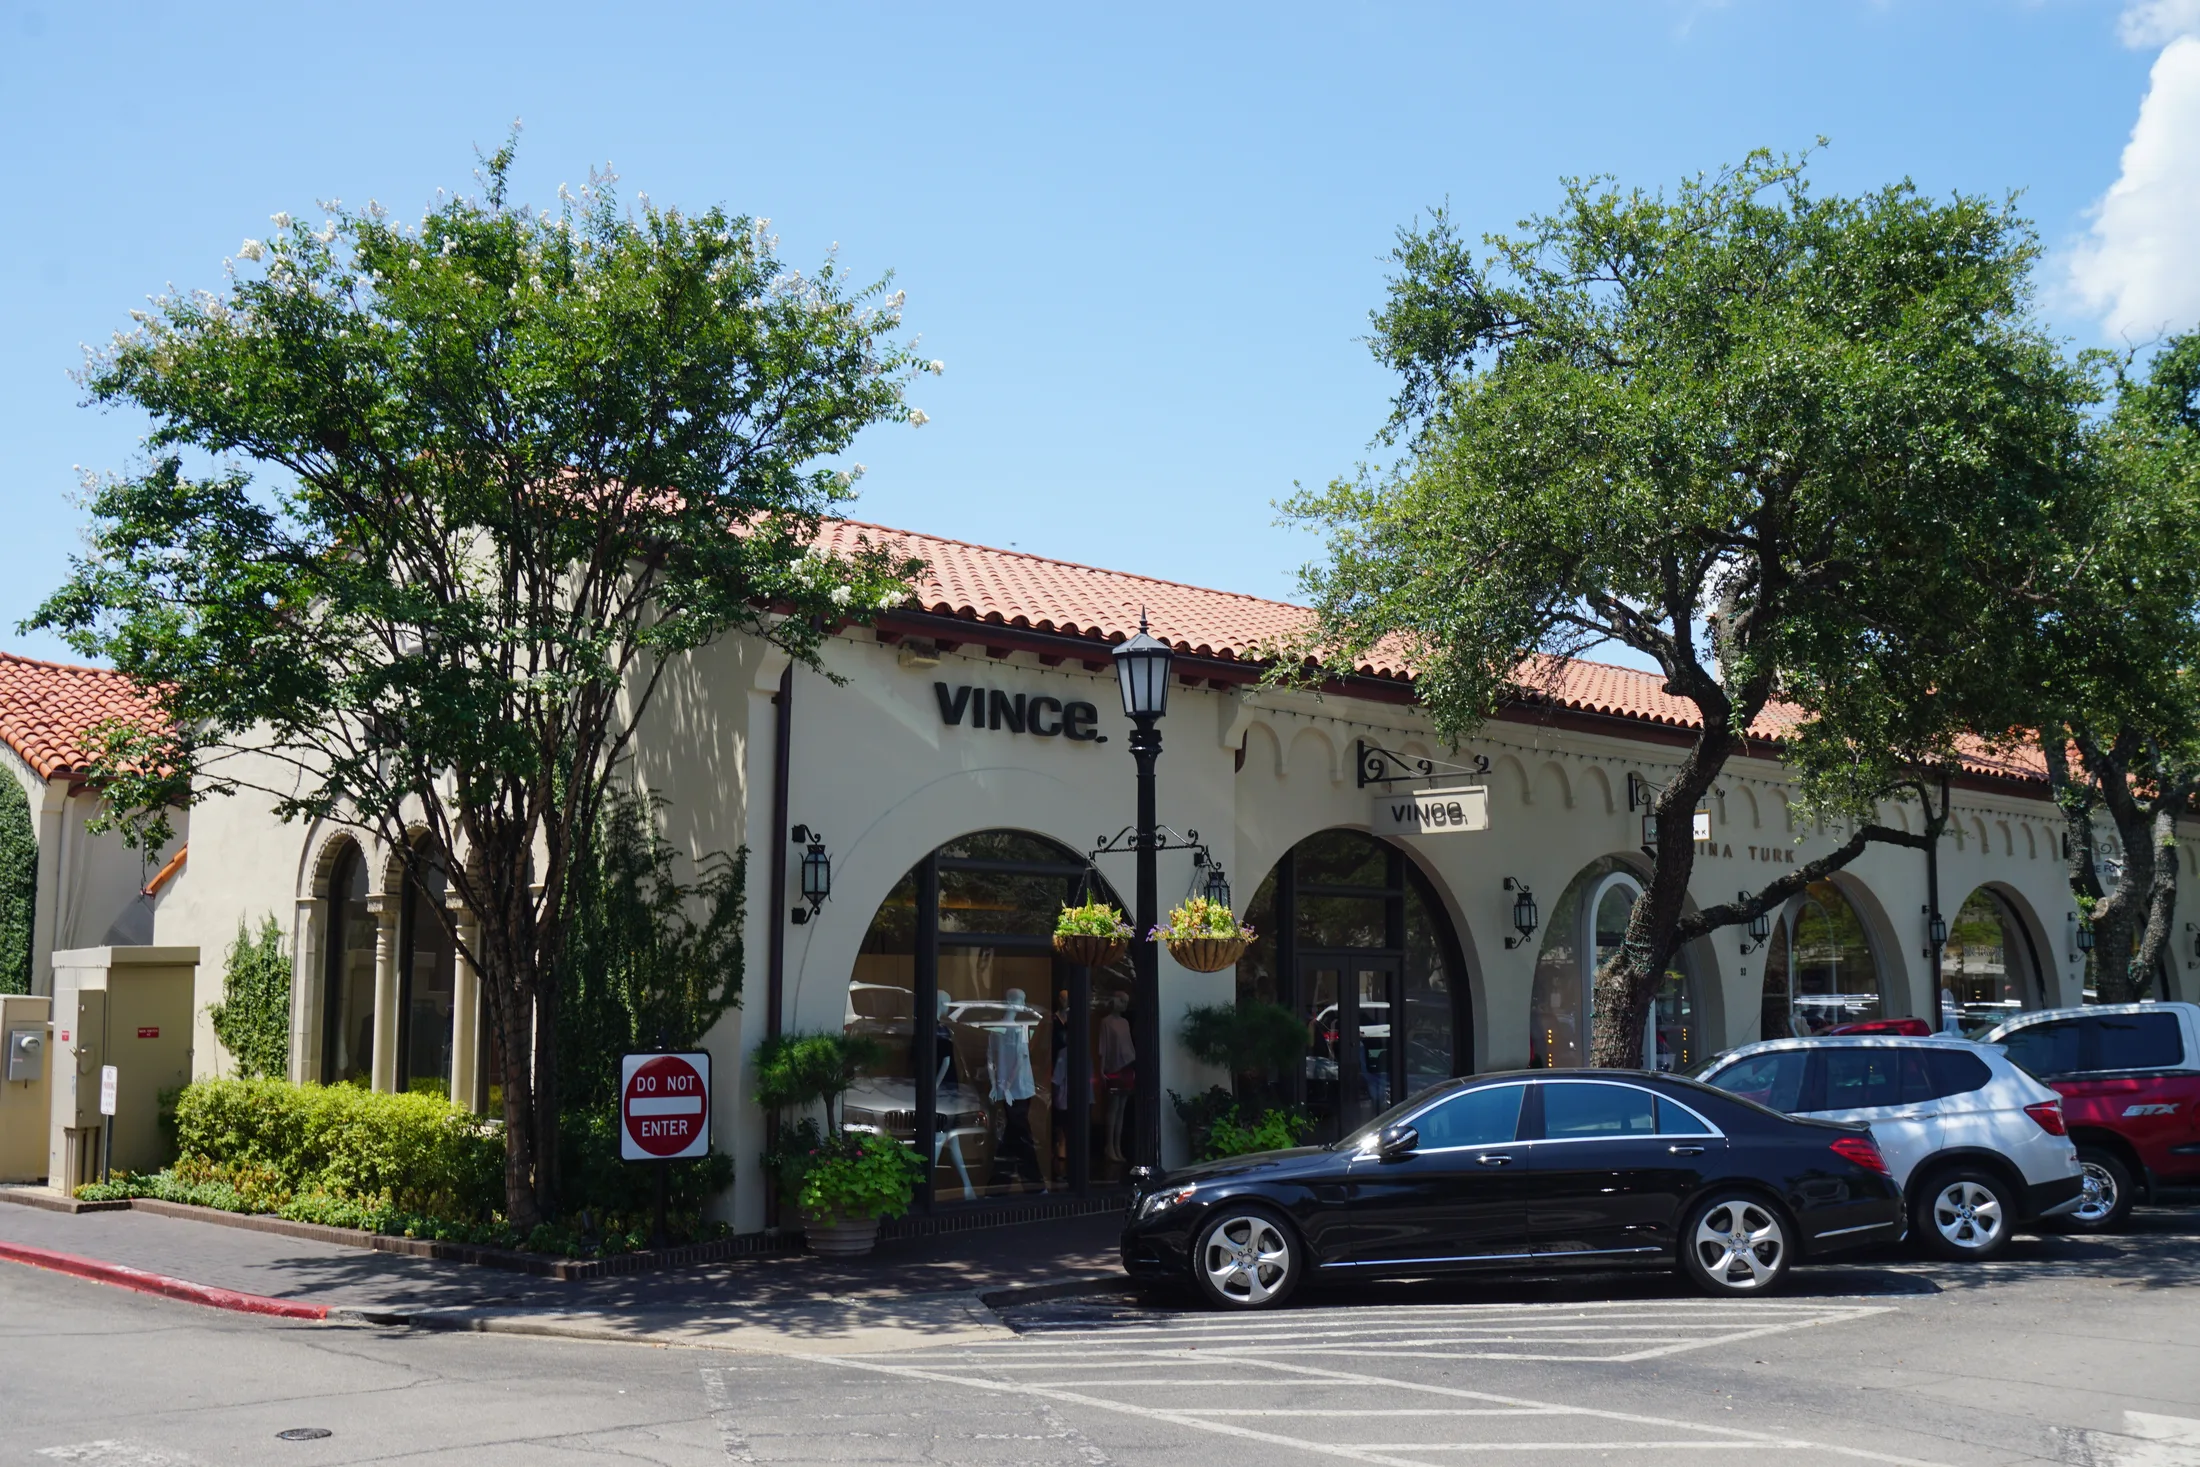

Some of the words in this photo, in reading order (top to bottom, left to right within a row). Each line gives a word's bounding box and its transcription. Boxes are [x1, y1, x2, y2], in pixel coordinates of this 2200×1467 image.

[1700, 842, 1733, 858] INA
[1748, 846, 1795, 863] TURK
[636, 1076, 657, 1092] DO
[667, 1075, 695, 1091] NOT
[2121, 1103, 2180, 1116] STX
[641, 1120, 688, 1137] ENTER
